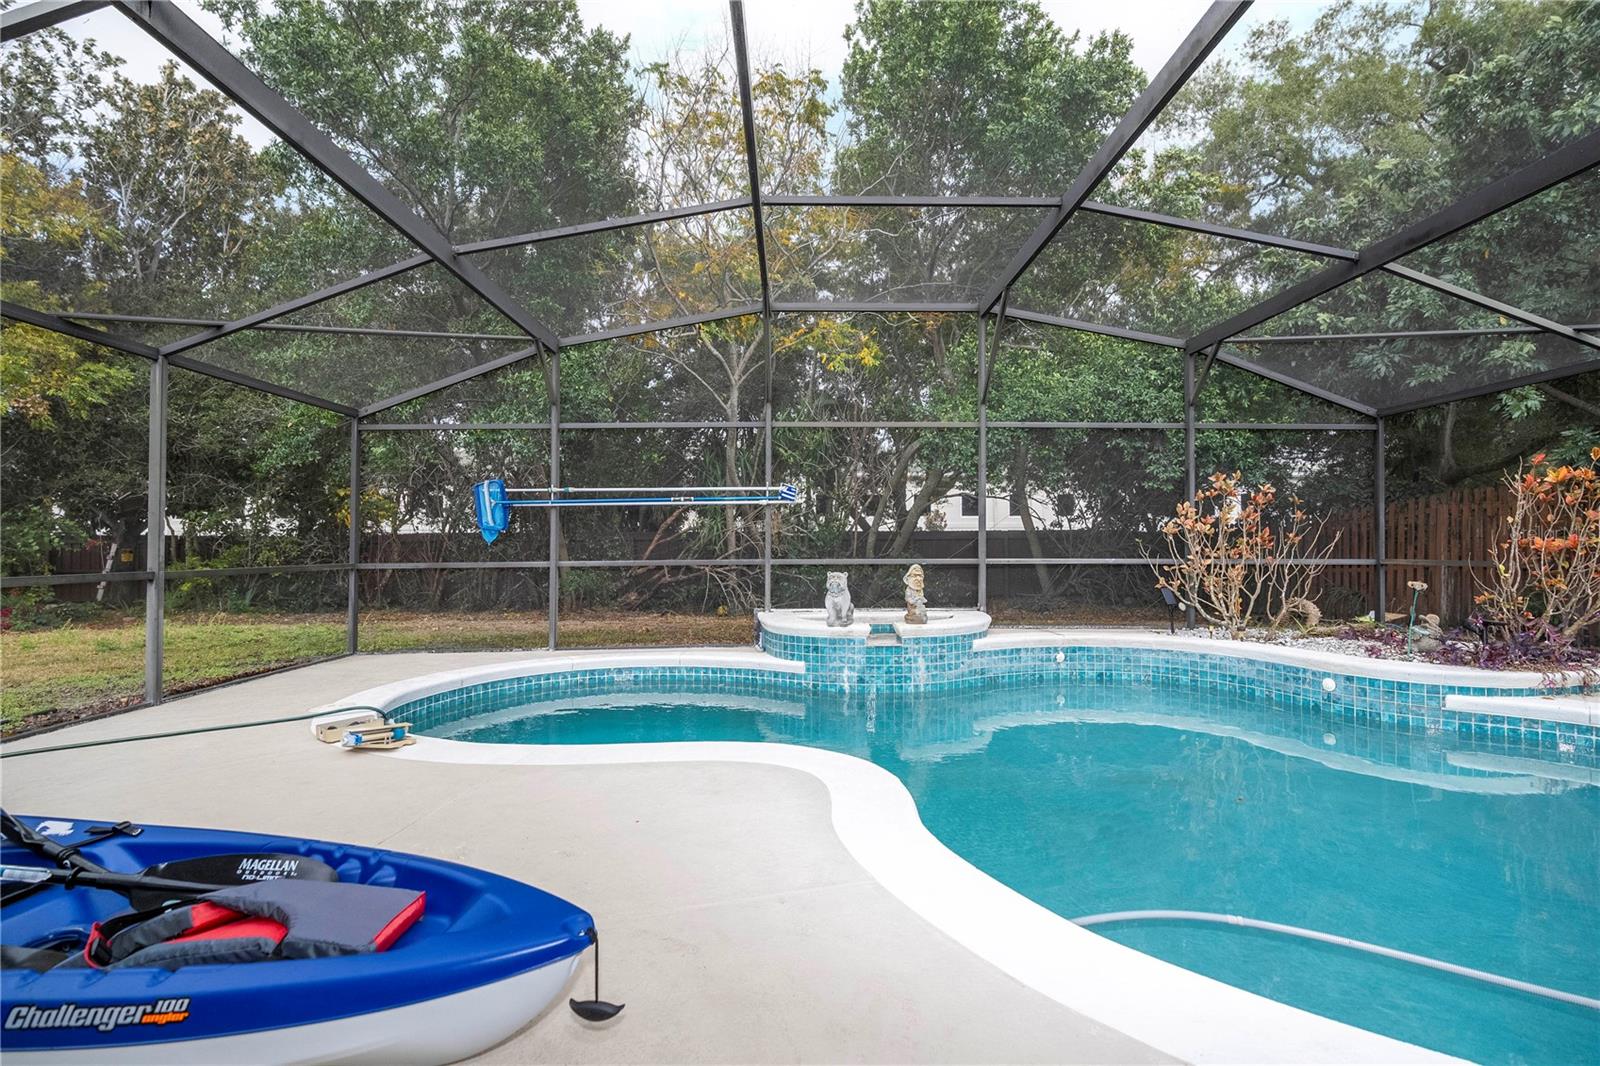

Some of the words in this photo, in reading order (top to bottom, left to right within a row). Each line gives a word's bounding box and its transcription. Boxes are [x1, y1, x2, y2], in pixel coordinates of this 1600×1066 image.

[238, 858, 299, 871] MAGELLAN
[4, 1004, 153, 1032] Challenger
[154, 998, 190, 1013] 100
[141, 1011, 190, 1024] angler
